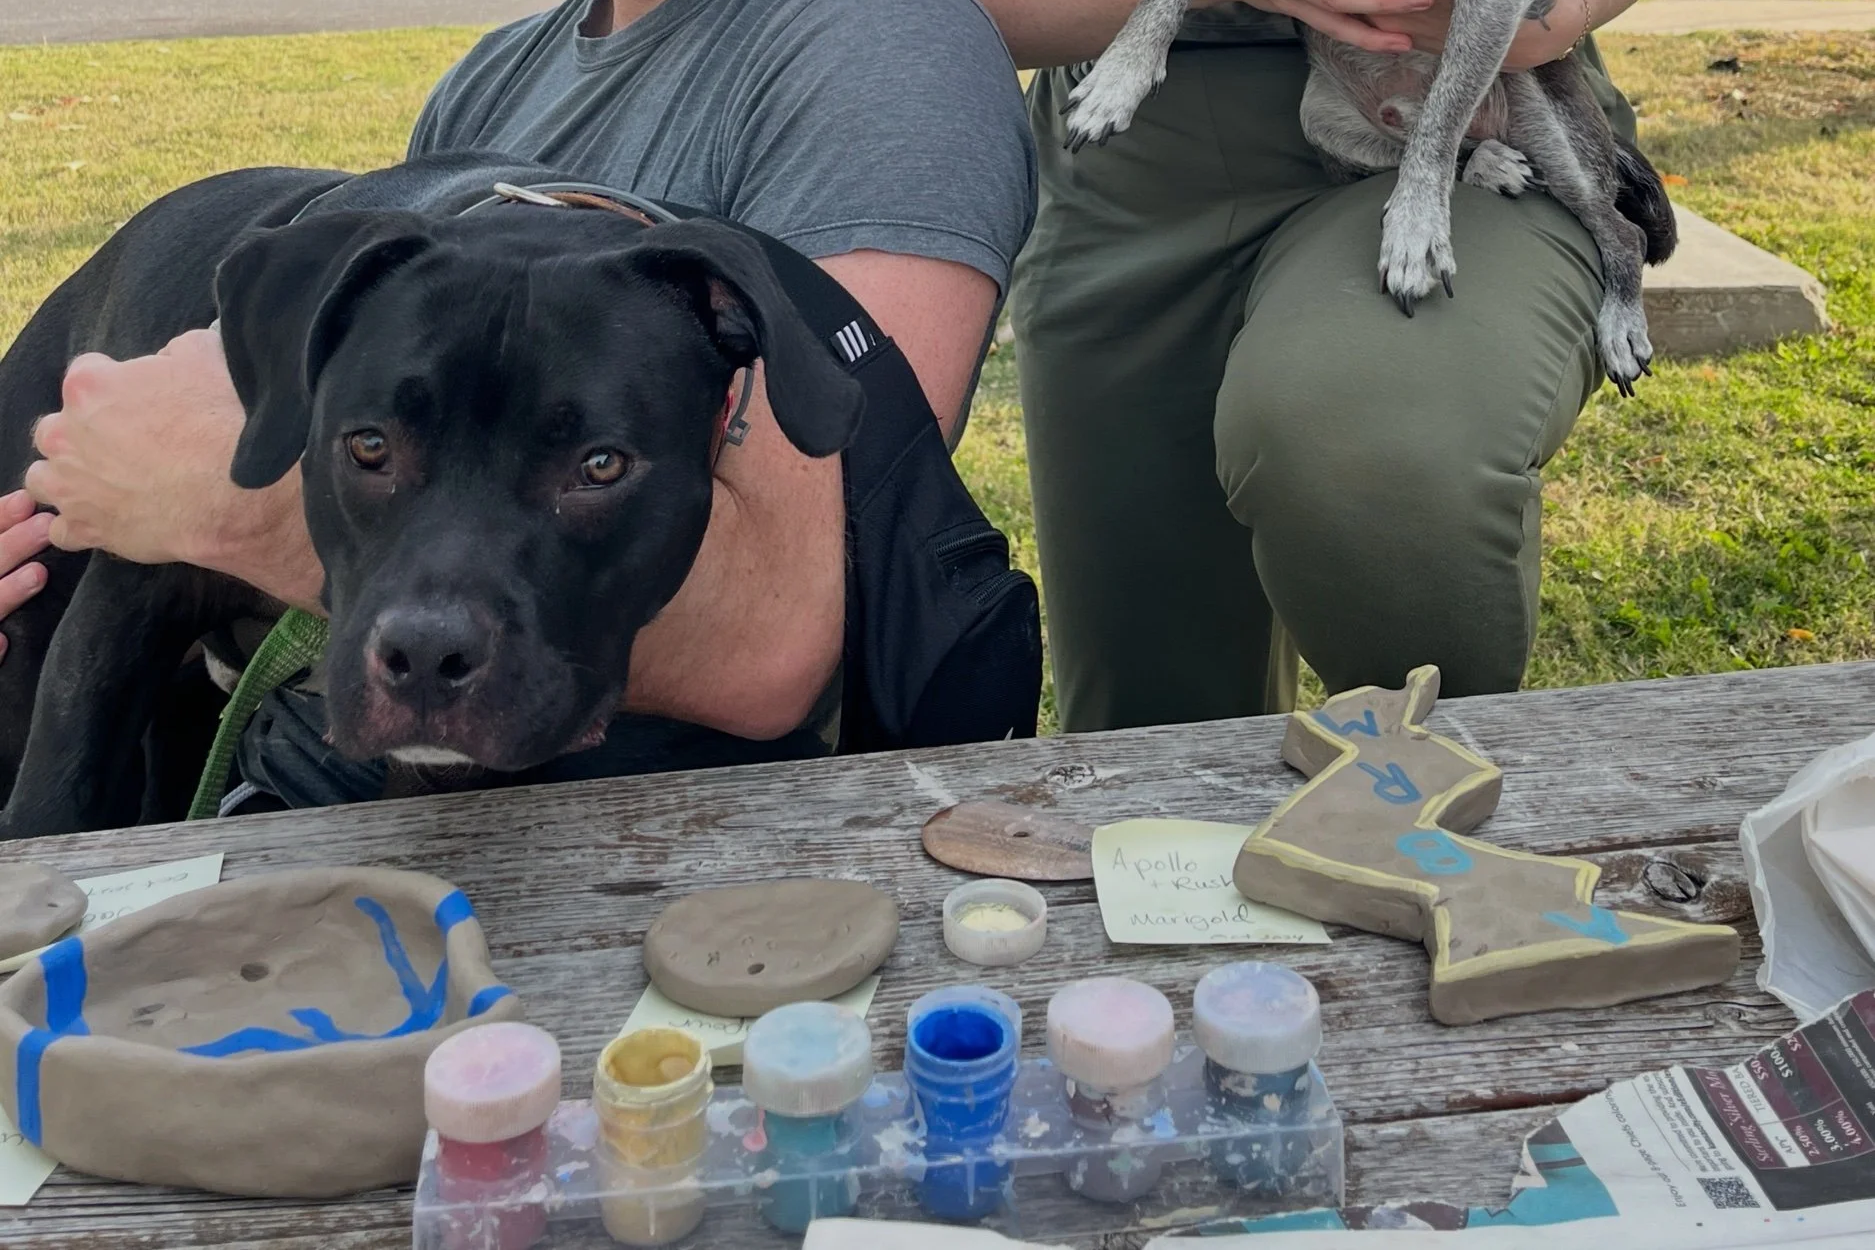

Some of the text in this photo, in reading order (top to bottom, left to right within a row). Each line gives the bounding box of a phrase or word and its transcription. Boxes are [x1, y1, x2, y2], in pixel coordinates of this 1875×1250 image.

[1112, 847, 1198, 880] Apollo
[1130, 903, 1256, 931] Marigold
[1794, 1125, 1820, 1157] 2.50%
[1814, 1119, 1843, 1152] 3.00%
[1668, 1184, 1687, 1208] Enjoy
